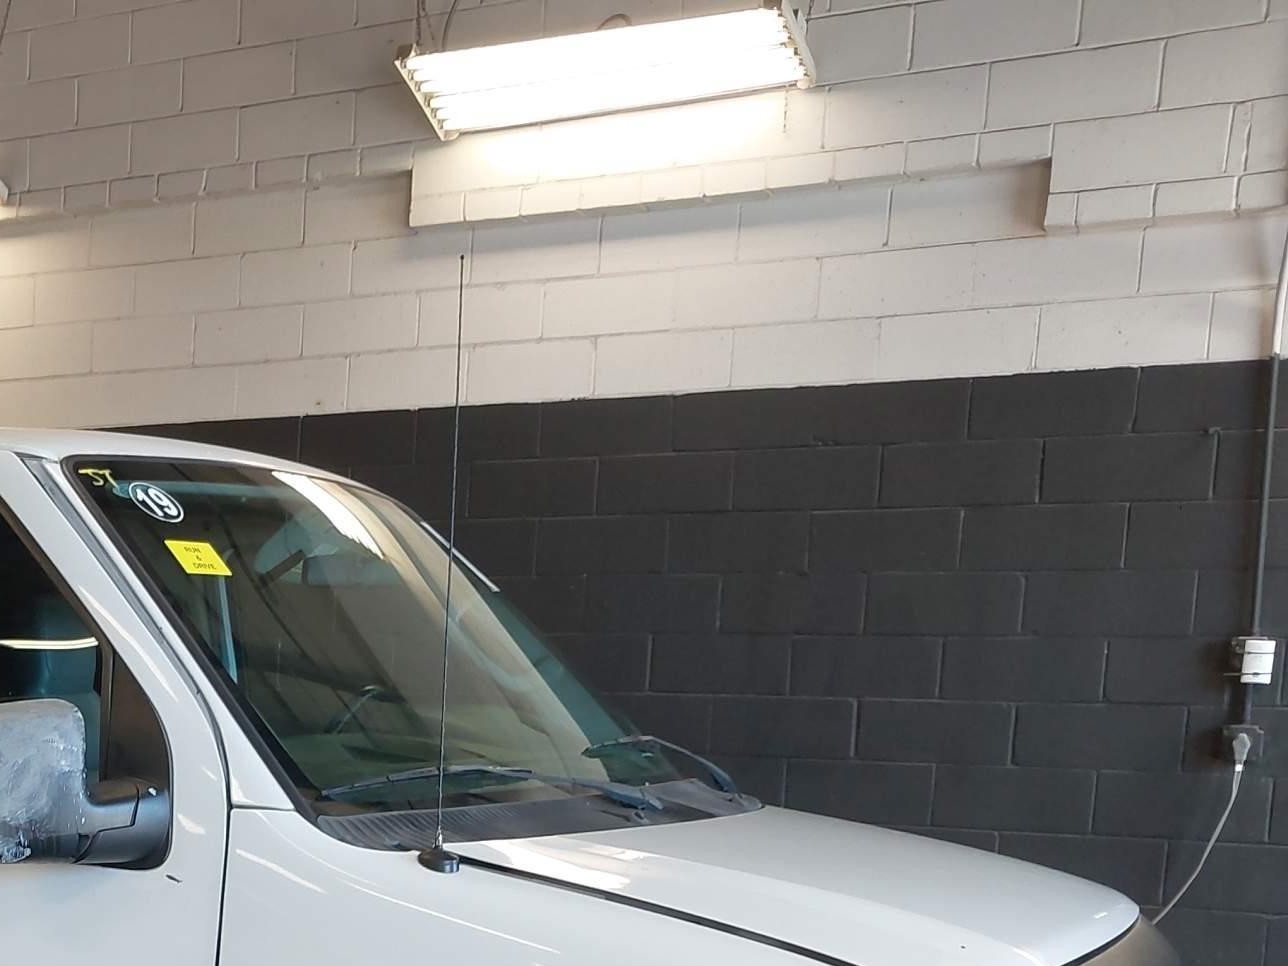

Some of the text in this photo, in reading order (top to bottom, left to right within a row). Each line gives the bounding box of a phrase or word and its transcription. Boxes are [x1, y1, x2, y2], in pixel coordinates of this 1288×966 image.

[136, 488, 179, 516] 19
[183, 546, 202, 554] RUN
[193, 562, 217, 570] DRIVE
